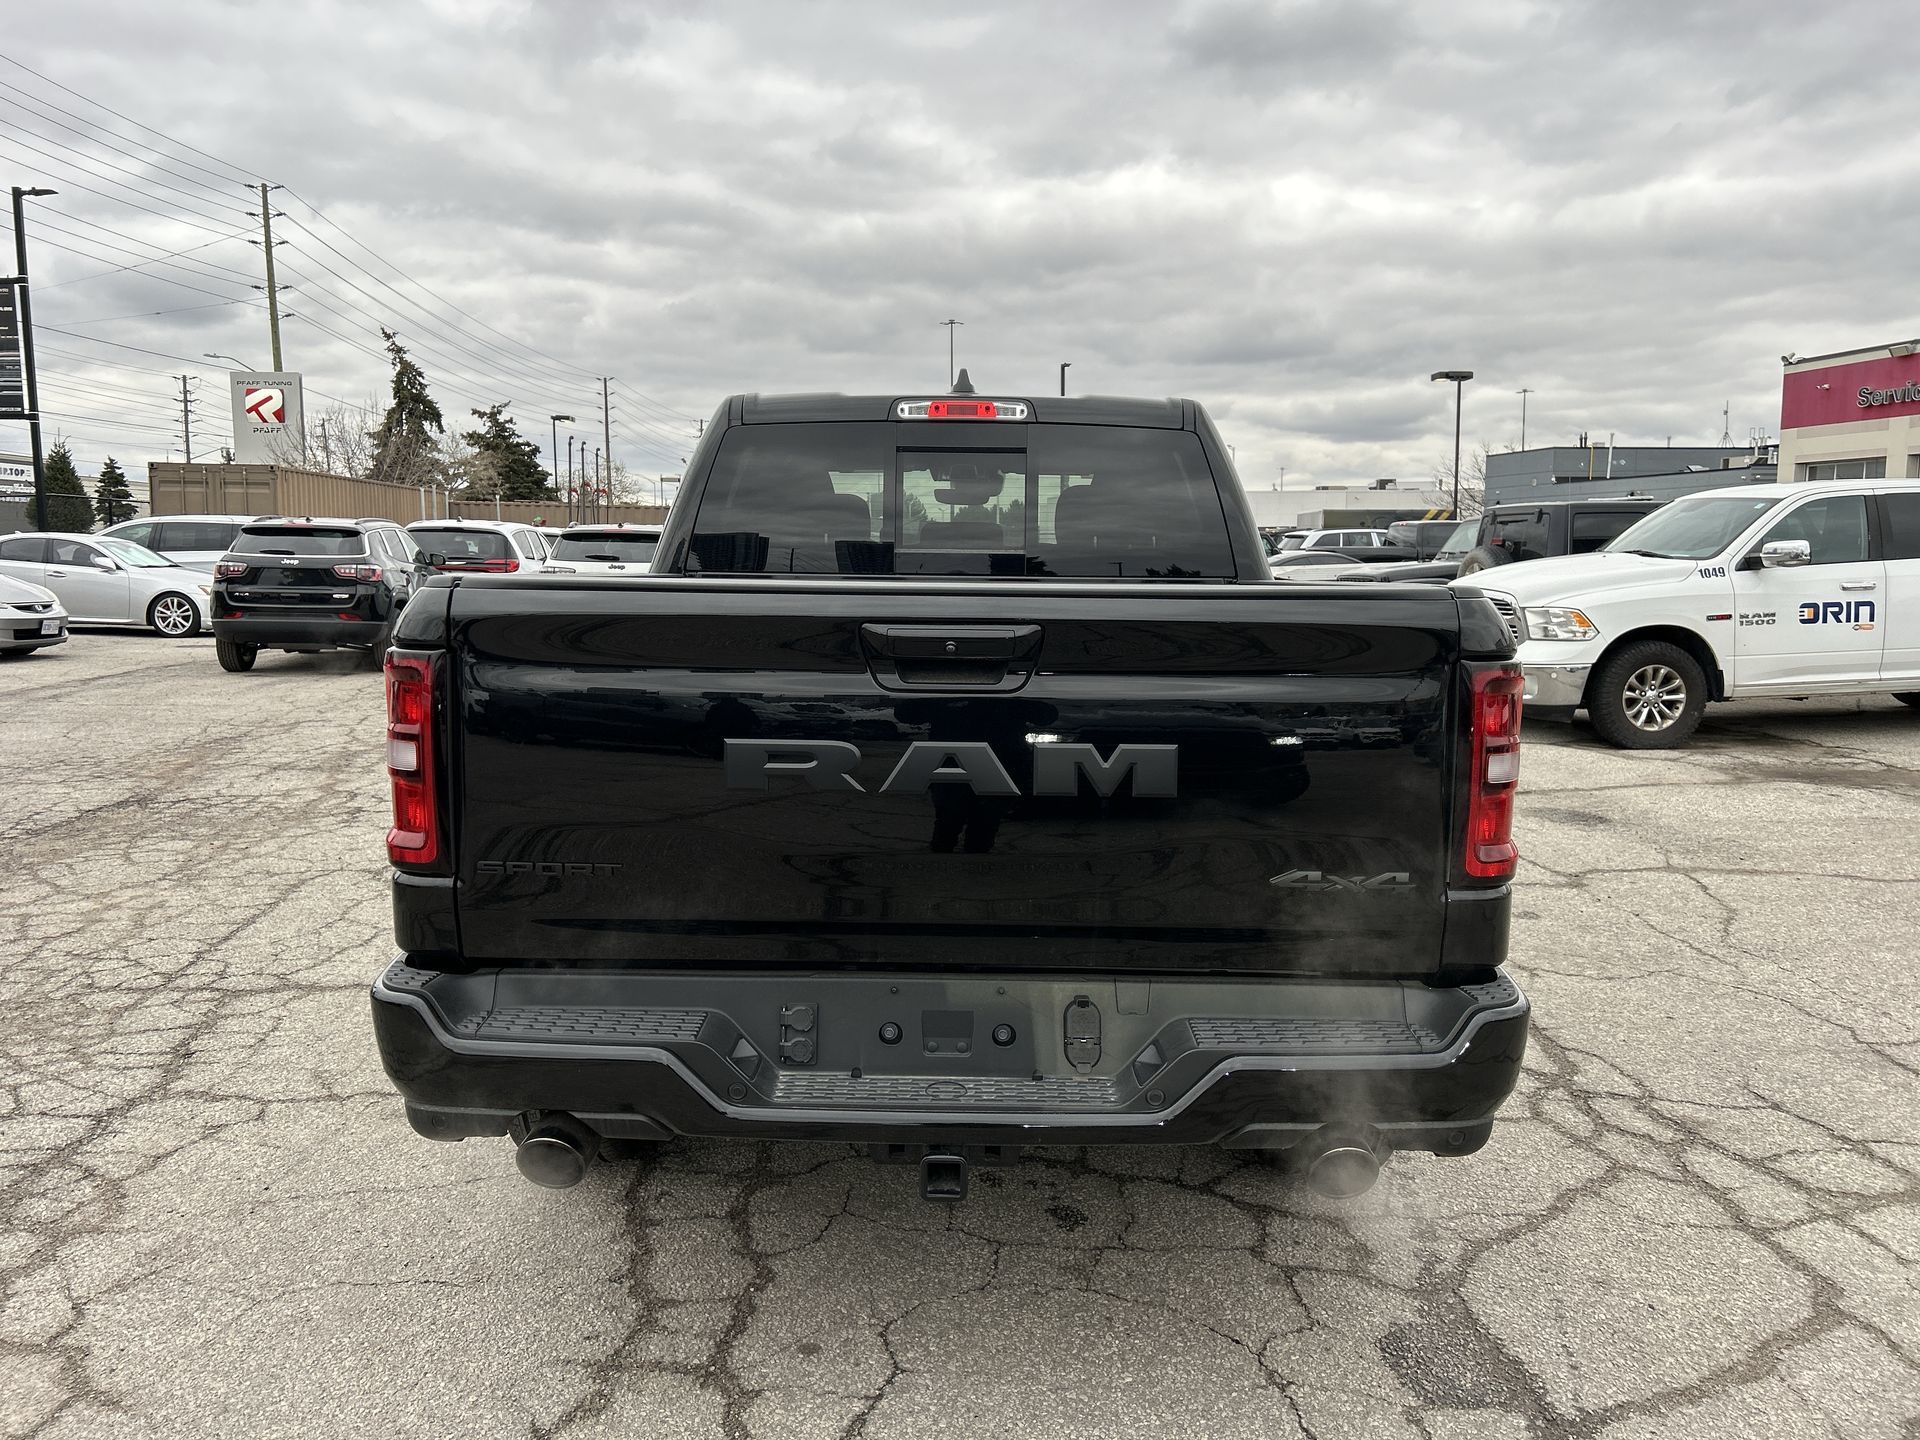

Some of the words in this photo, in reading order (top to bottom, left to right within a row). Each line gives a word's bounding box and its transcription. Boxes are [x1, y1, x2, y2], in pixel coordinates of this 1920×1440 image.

[607, 563, 626, 571] Jeep
[1698, 566, 1726, 579] 1049
[1739, 612, 1777, 620] RAM
[1739, 618, 1777, 627] 1500
[723, 737, 1179, 797] RAM
[476, 860, 625, 879] SPORT
